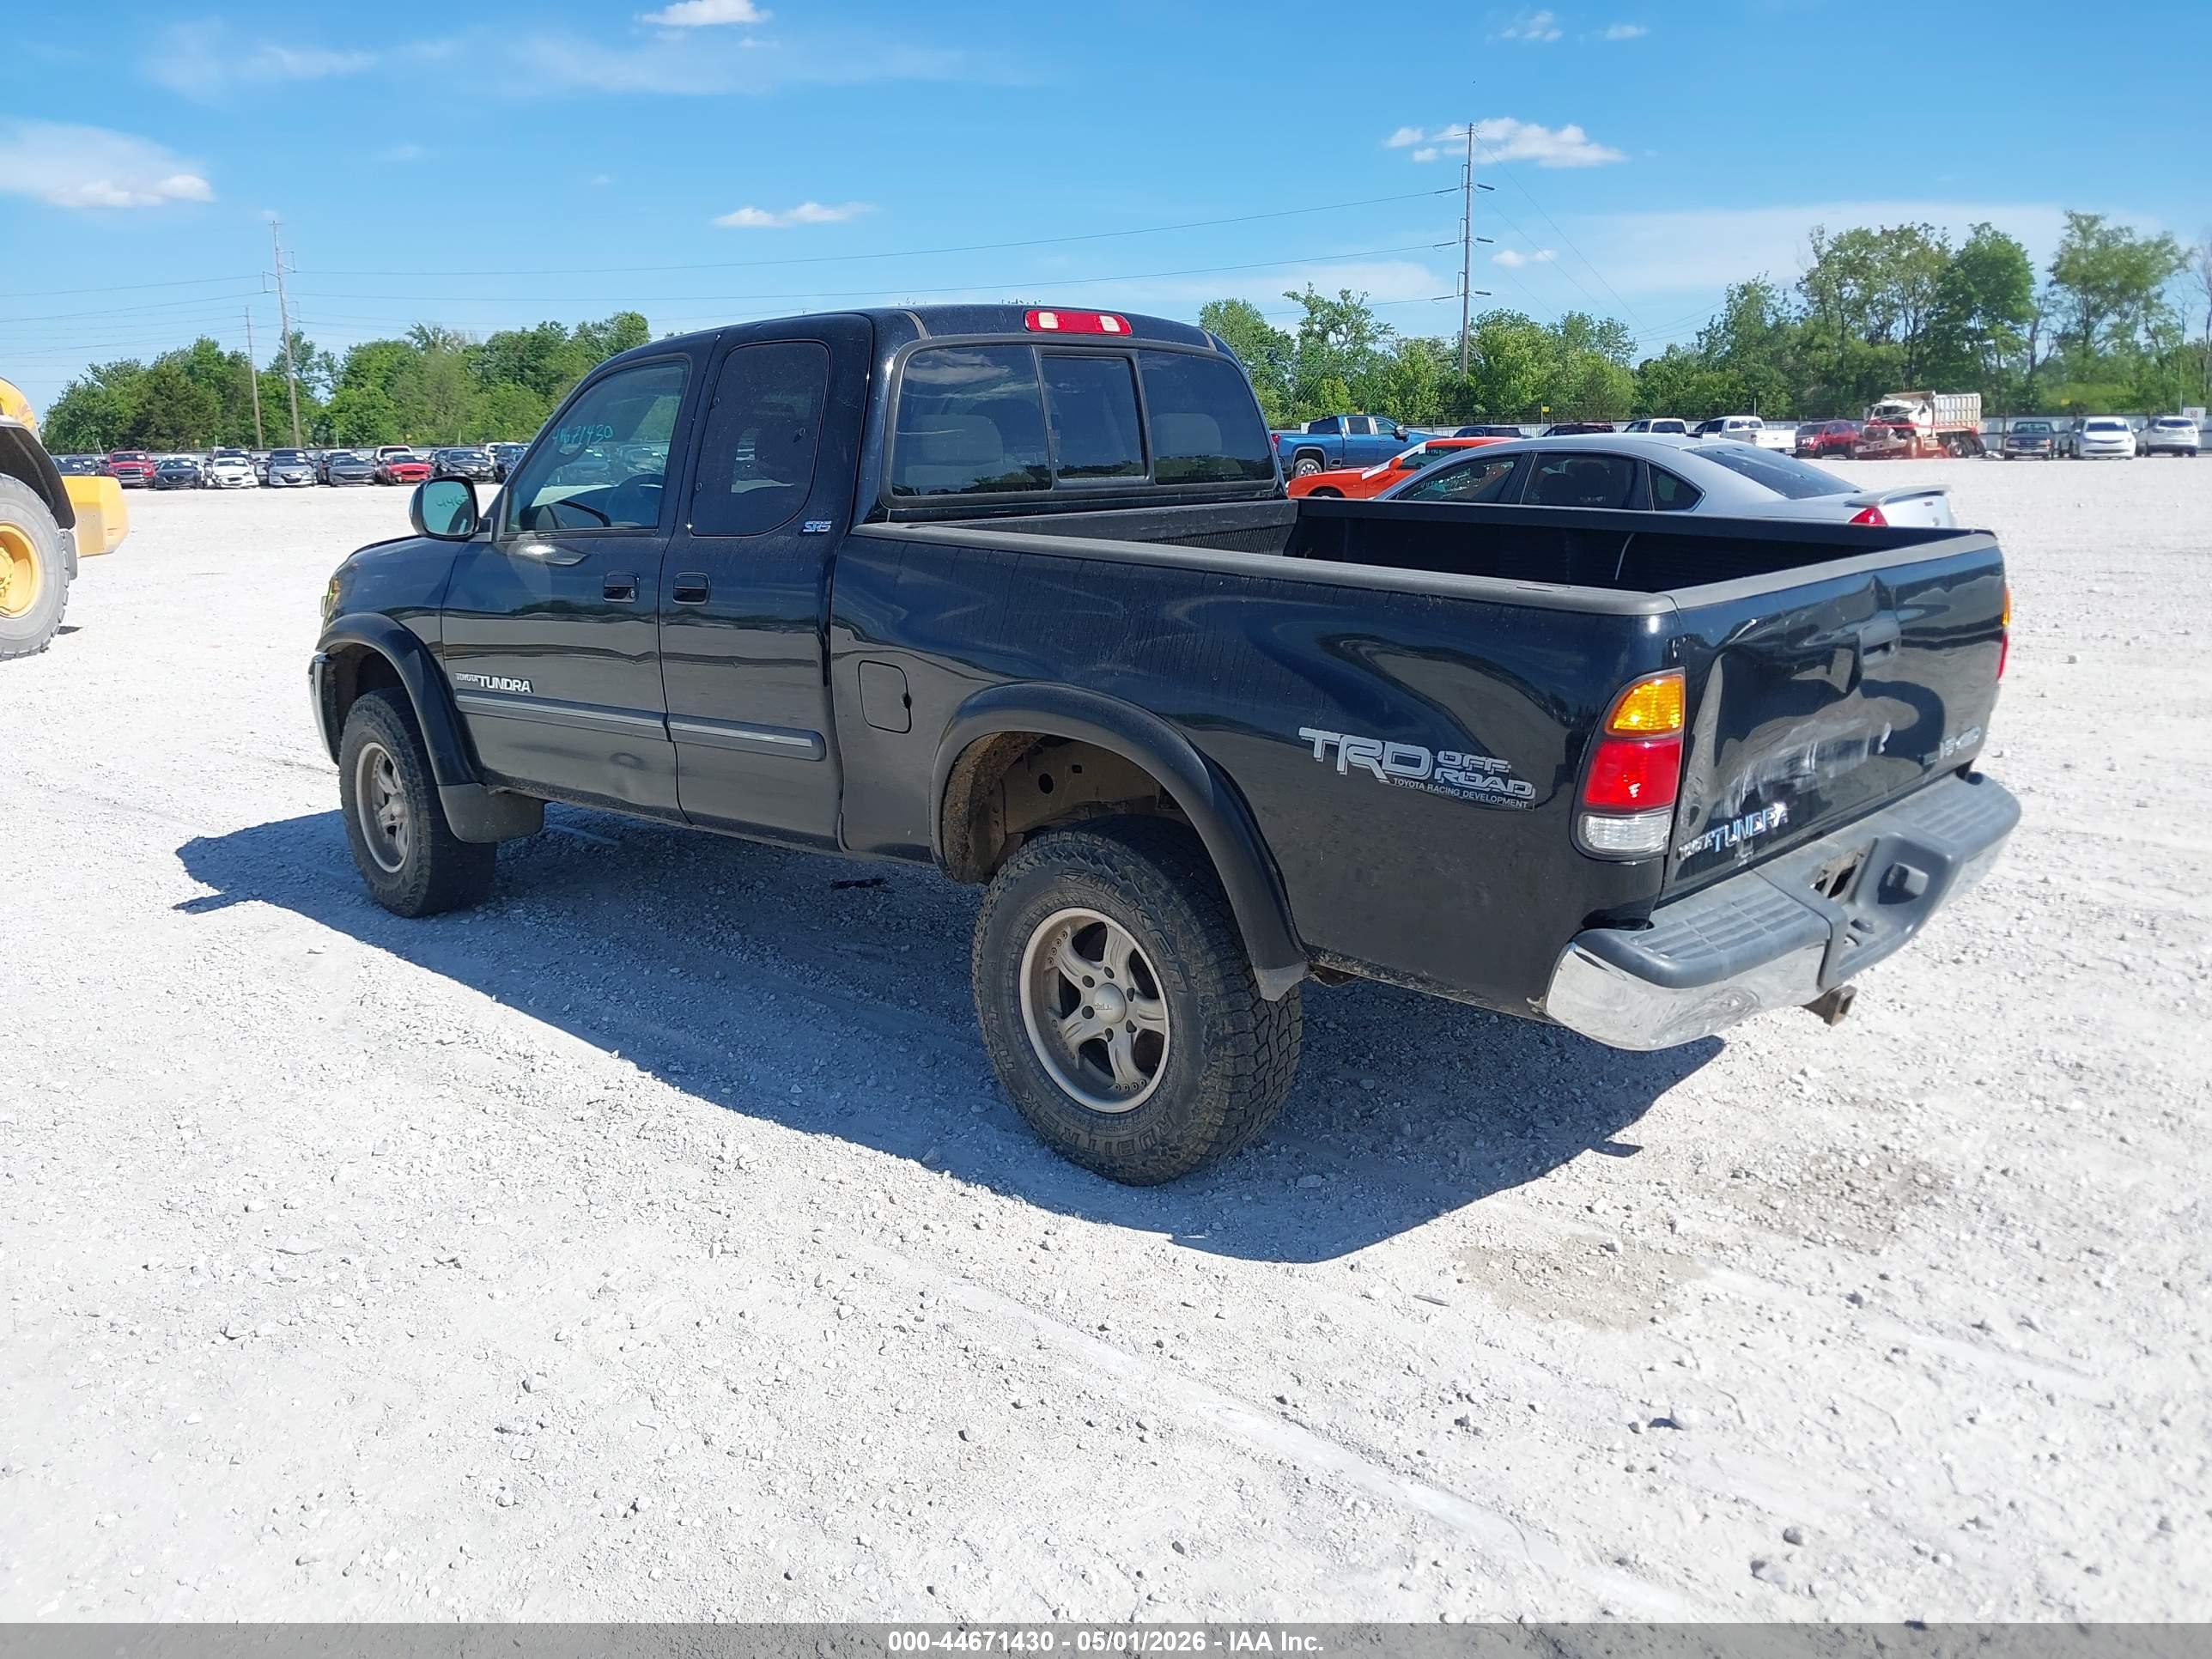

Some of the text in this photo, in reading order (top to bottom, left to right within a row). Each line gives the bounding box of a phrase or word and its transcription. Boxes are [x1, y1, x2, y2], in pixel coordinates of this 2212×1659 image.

[478, 675, 532, 693] TUNDRA
[1298, 726, 1433, 784] TRD
[1437, 750, 1512, 775] OFF
[1394, 777, 1529, 809] TOYOTA RACING DEVELOPMENT
[1435, 769, 1536, 799] ROAD
[1708, 802, 1789, 853] TUNDRA
